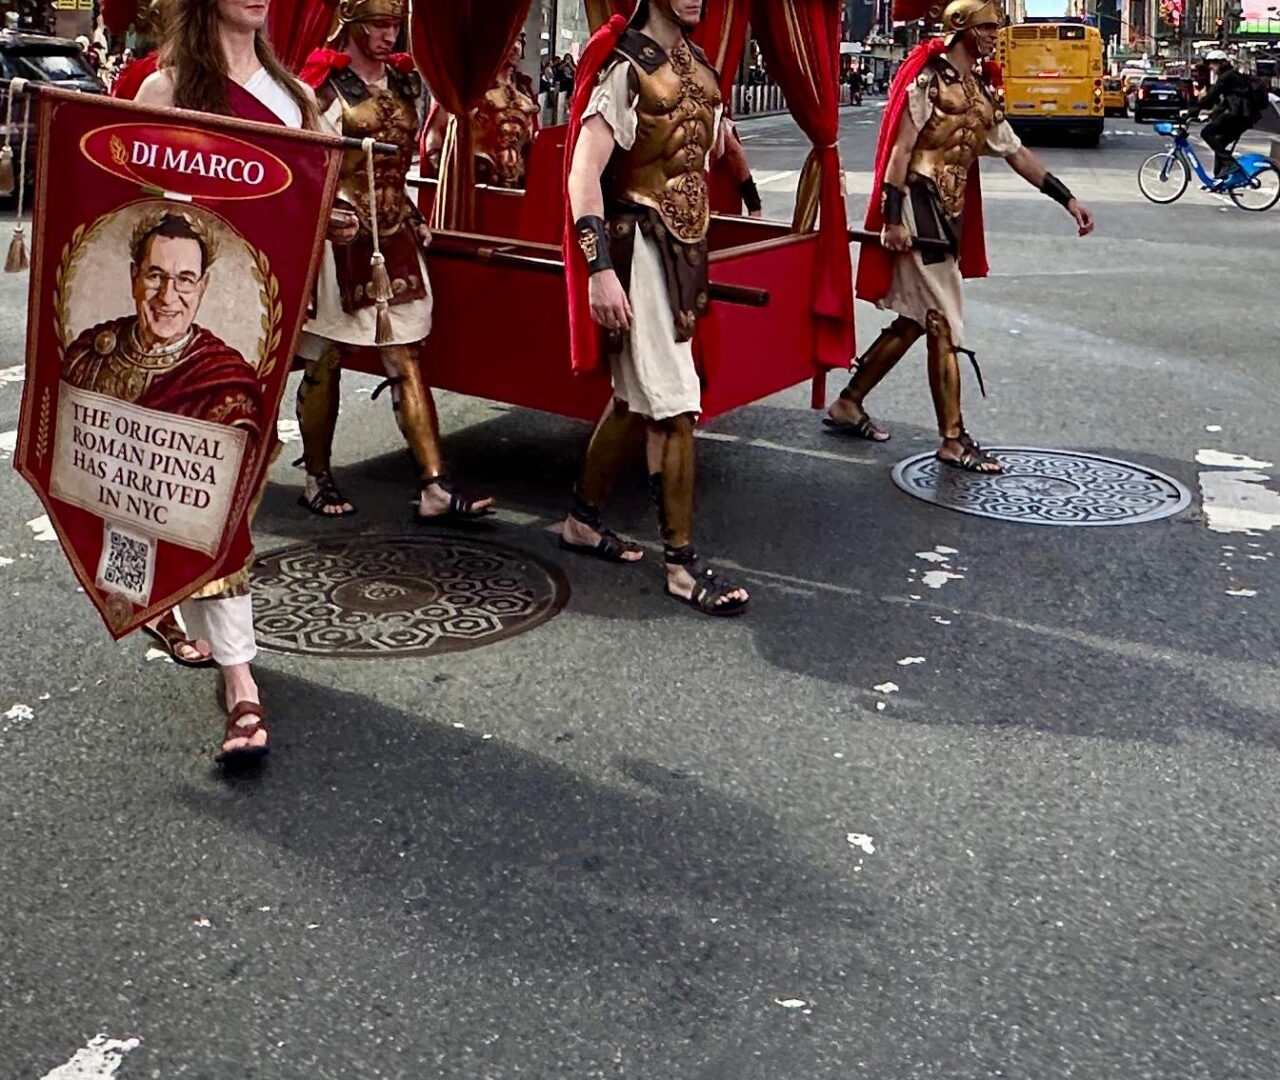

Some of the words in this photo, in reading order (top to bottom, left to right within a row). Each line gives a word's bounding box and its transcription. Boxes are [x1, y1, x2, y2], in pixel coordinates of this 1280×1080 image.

[132, 141, 156, 167] DI
[161, 149, 265, 185] MARCO
[71, 404, 112, 429] THE
[115, 416, 224, 460] ORIGINAL
[73, 426, 145, 466] ROMAN
[150, 453, 217, 485] PINSA
[73, 450, 107, 479] HAS
[111, 467, 211, 509] ARRIVED
[99, 484, 120, 508] IN
[126, 495, 169, 524] NYC
